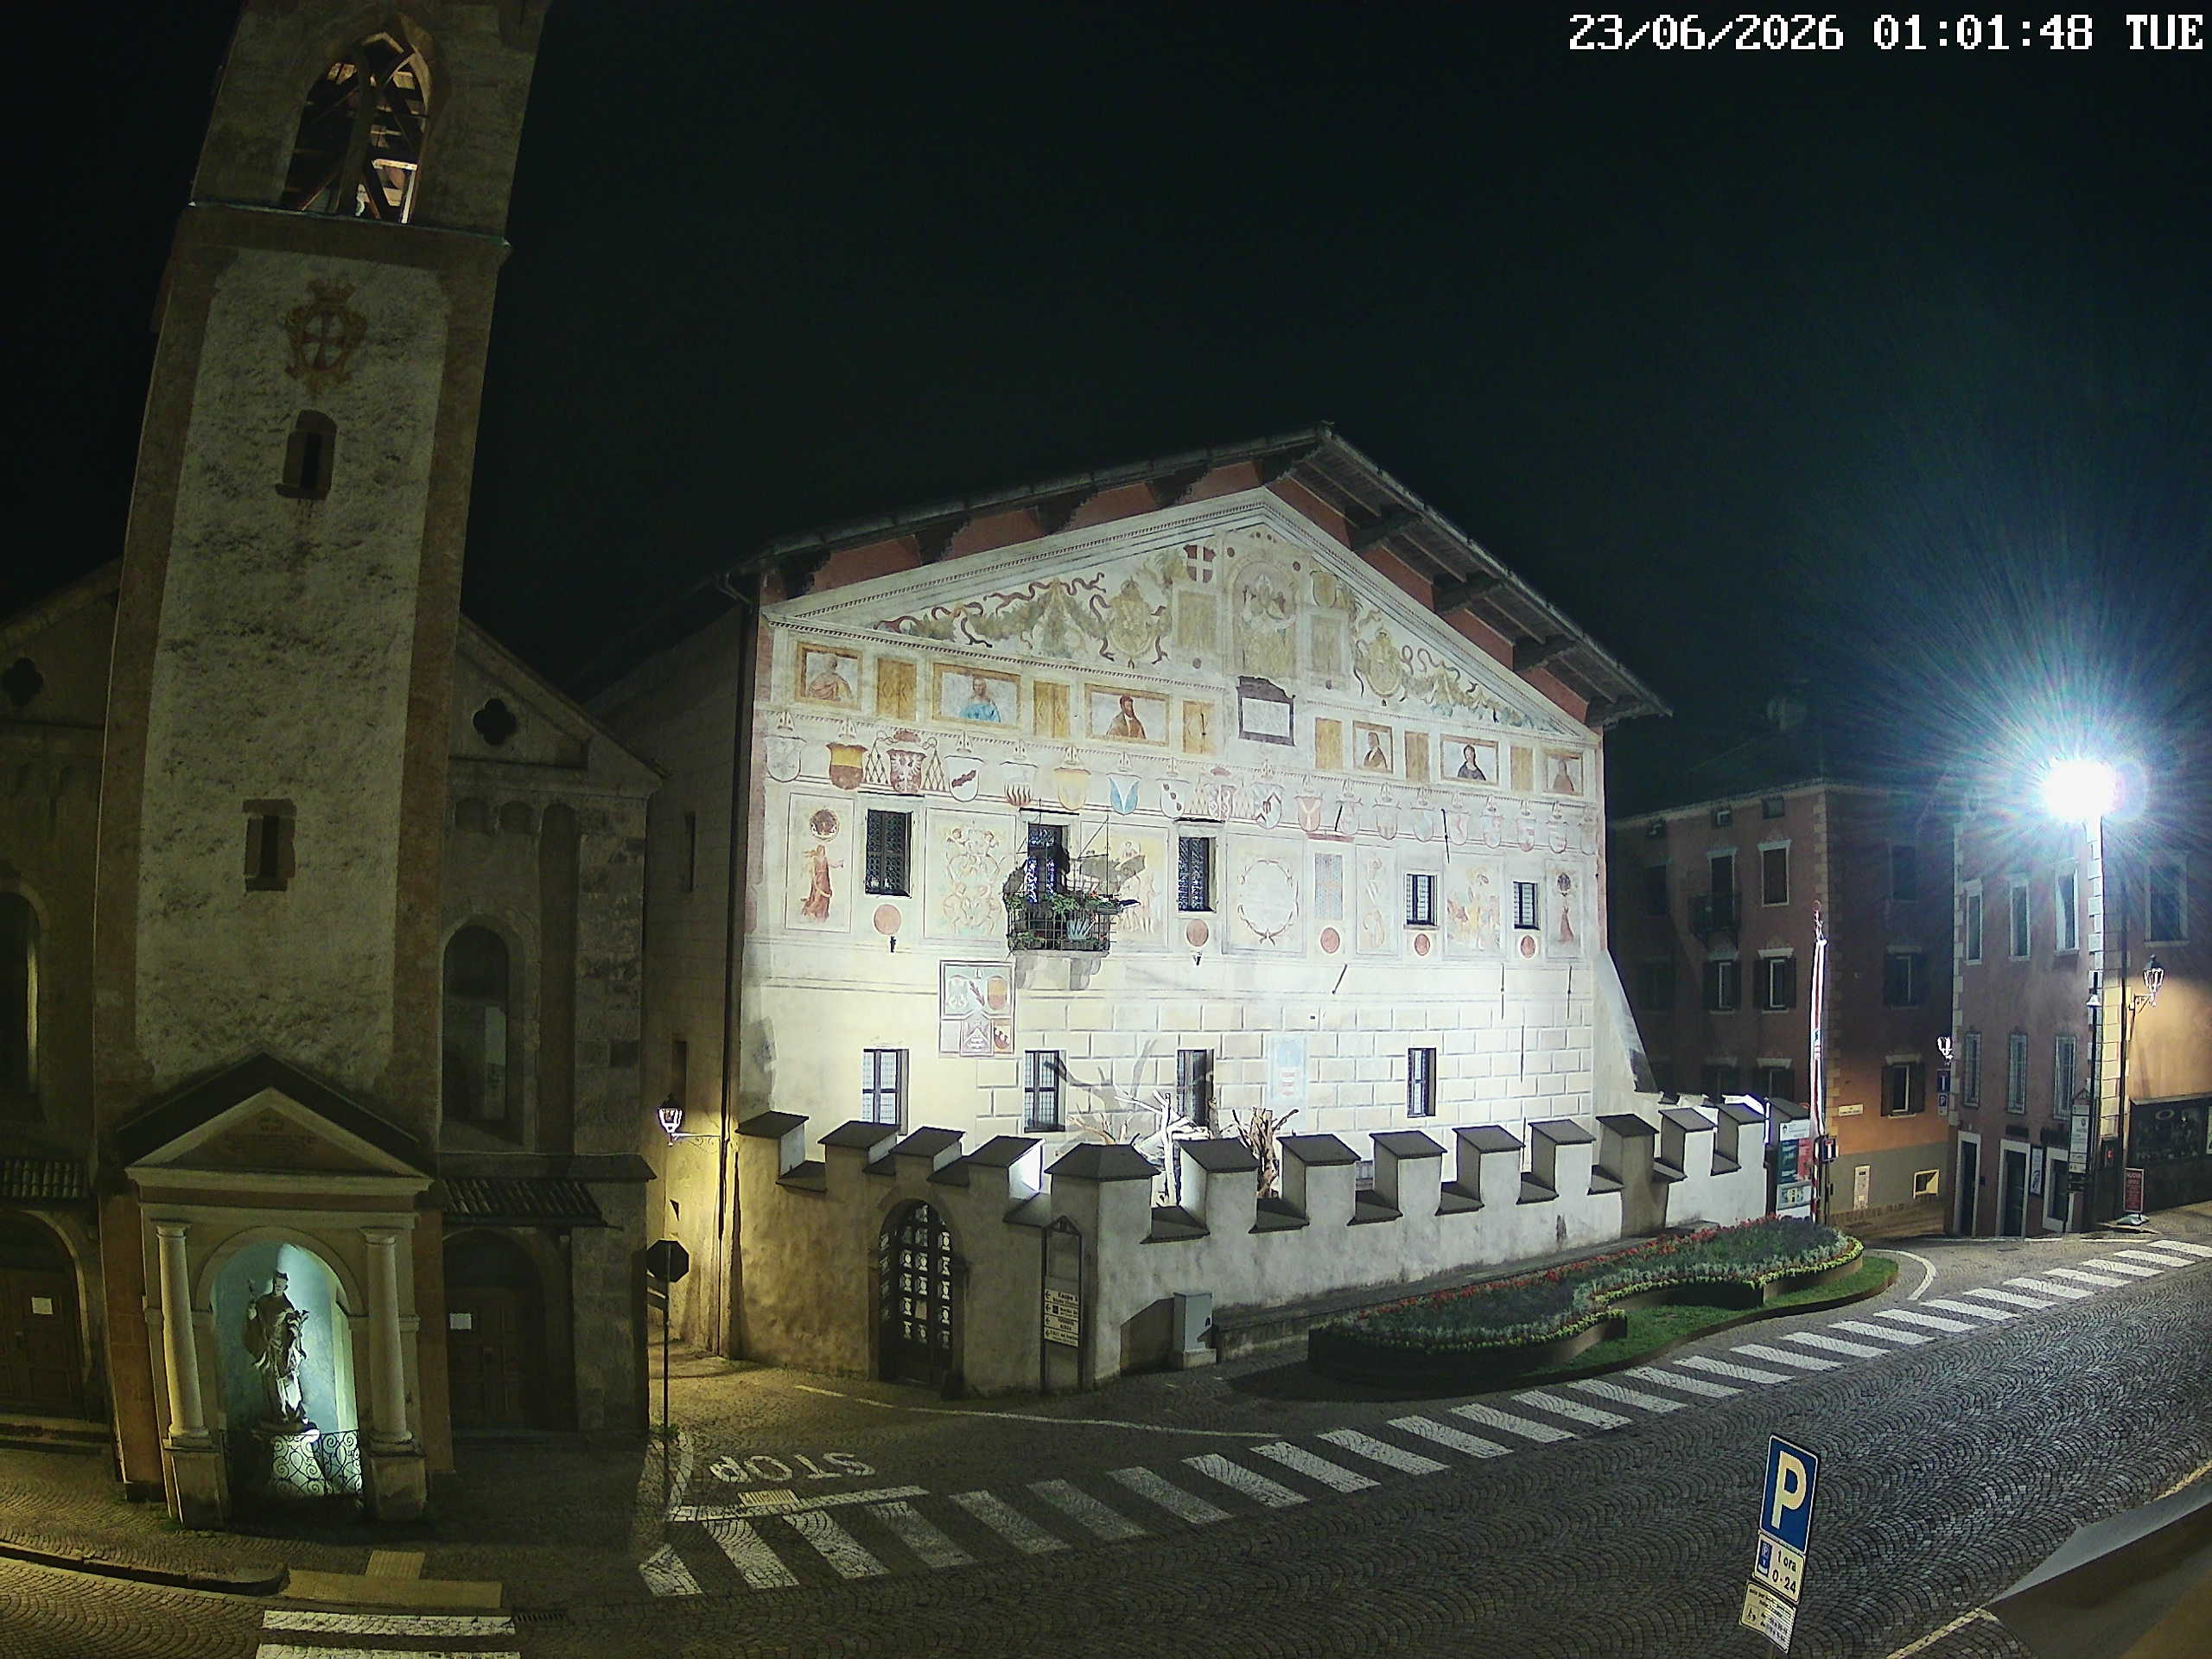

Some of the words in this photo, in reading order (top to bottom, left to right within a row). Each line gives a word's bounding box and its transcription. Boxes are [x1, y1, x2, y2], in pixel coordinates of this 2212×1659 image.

[709, 1452, 876, 1484] STOP
[1771, 1450, 1807, 1529] P
[1777, 1549, 1782, 1563] 1
[1783, 1556, 1796, 1573] ora
